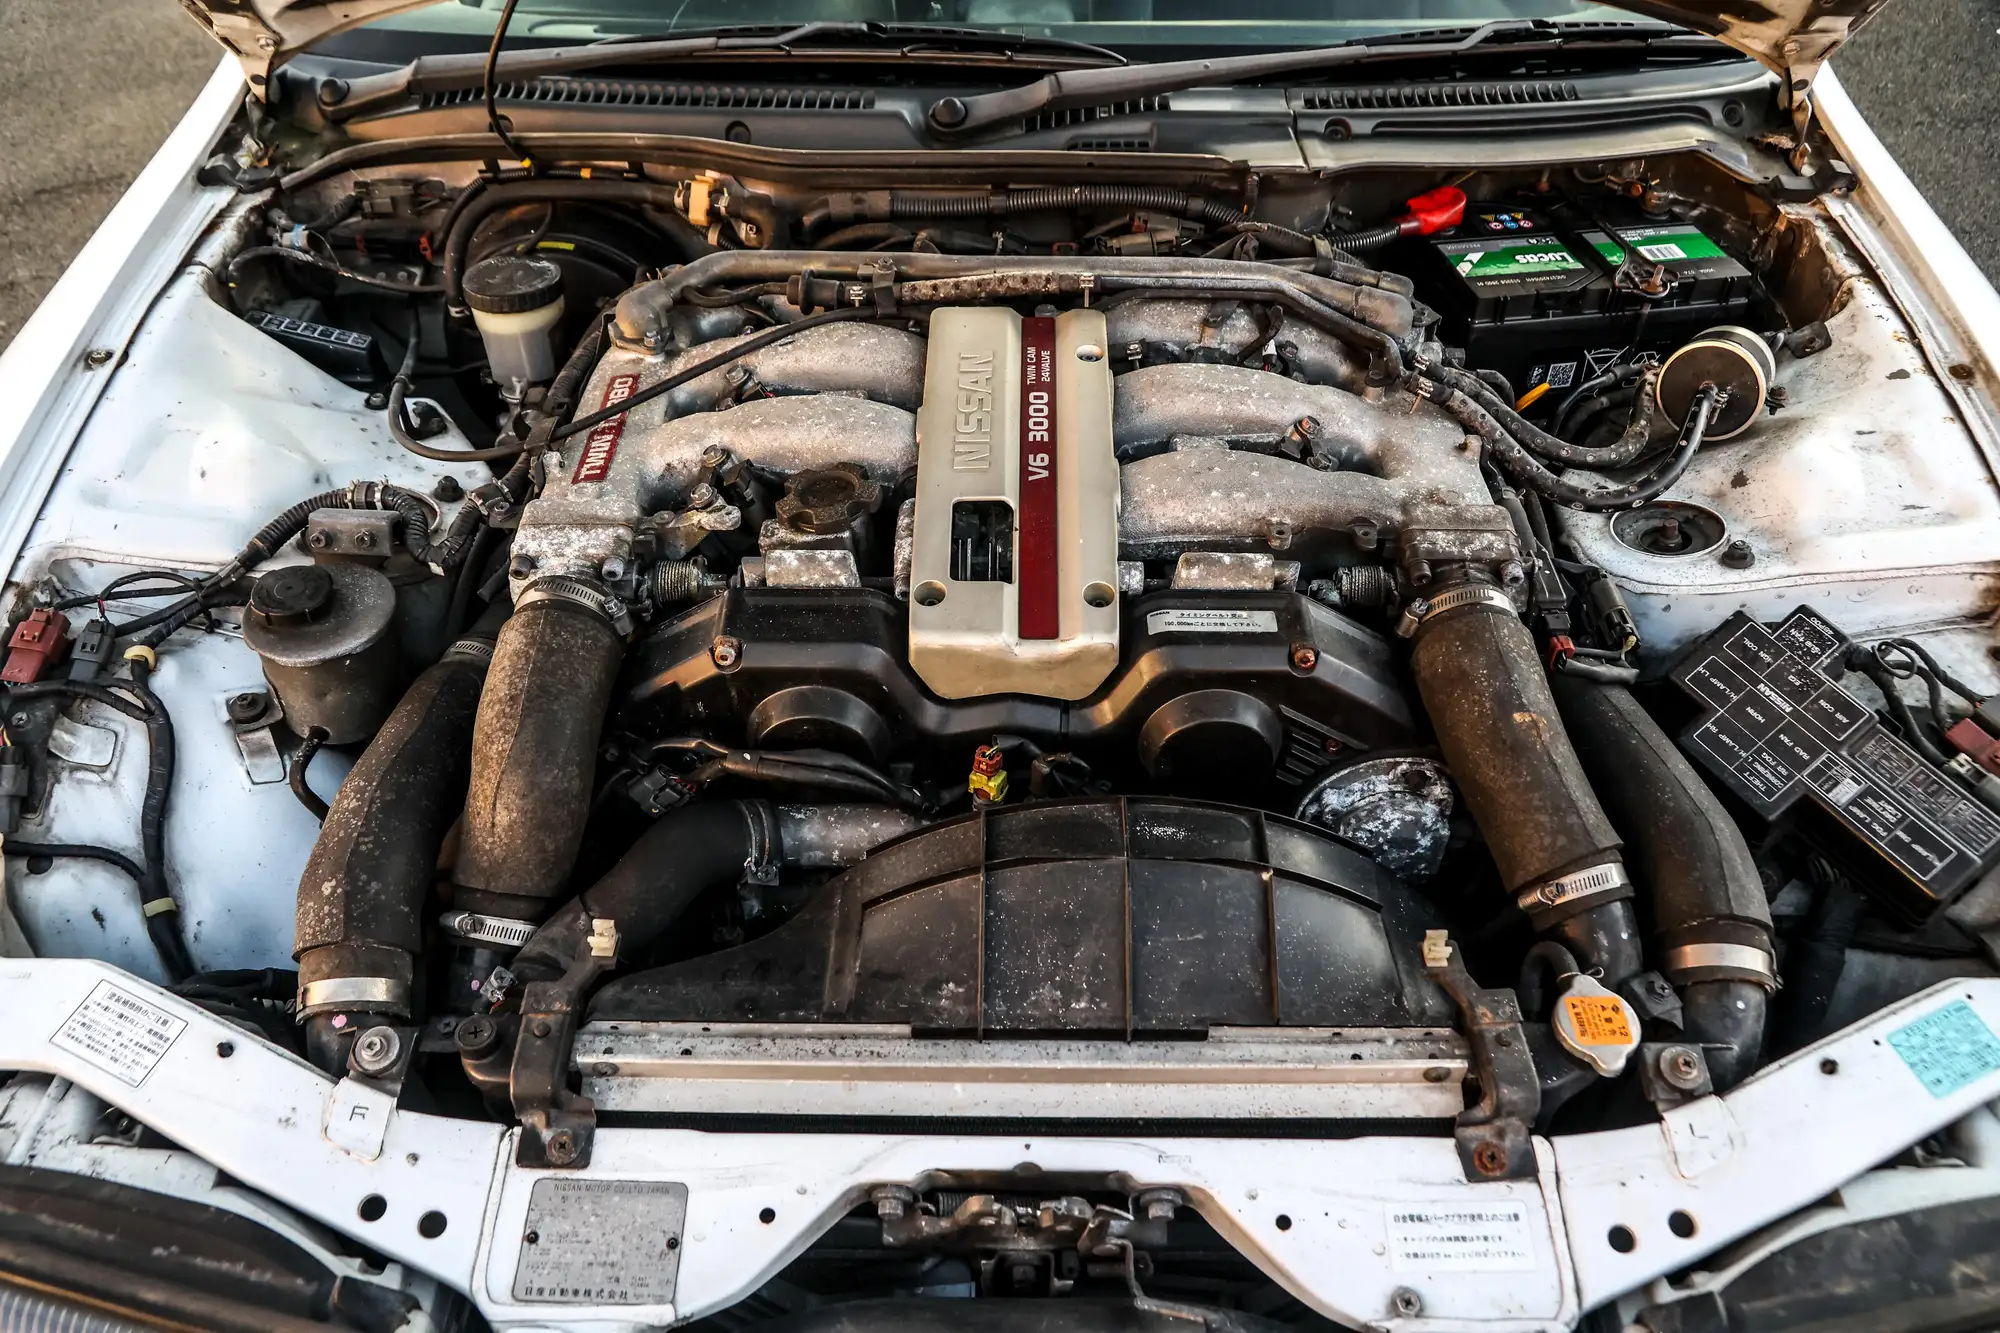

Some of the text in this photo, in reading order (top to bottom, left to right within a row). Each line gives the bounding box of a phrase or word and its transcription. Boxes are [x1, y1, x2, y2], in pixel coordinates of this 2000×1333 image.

[1515, 251, 1574, 264] Lucas
[1026, 346, 1036, 385] TWIN CAM
[1041, 350, 1050, 382] 24VALVE
[953, 350, 994, 471] NISSAN
[579, 377, 633, 480] TWIN TBO
[1028, 391, 1049, 481] V6 3000
[1741, 636, 1759, 652] COIL
[1708, 675, 1738, 701] H/LAMP
[1756, 682, 1794, 713] NISSAN
[1745, 706, 1766, 724] HORN
[1818, 698, 1849, 725] AIR CON
[1706, 722, 1748, 757] H/LAMP RH
[1778, 733, 1811, 761] RAD FAN
[1760, 751, 1789, 776] RR FOG
[1742, 770, 1768, 792] THEFT
[1870, 821, 1889, 838] FOG
